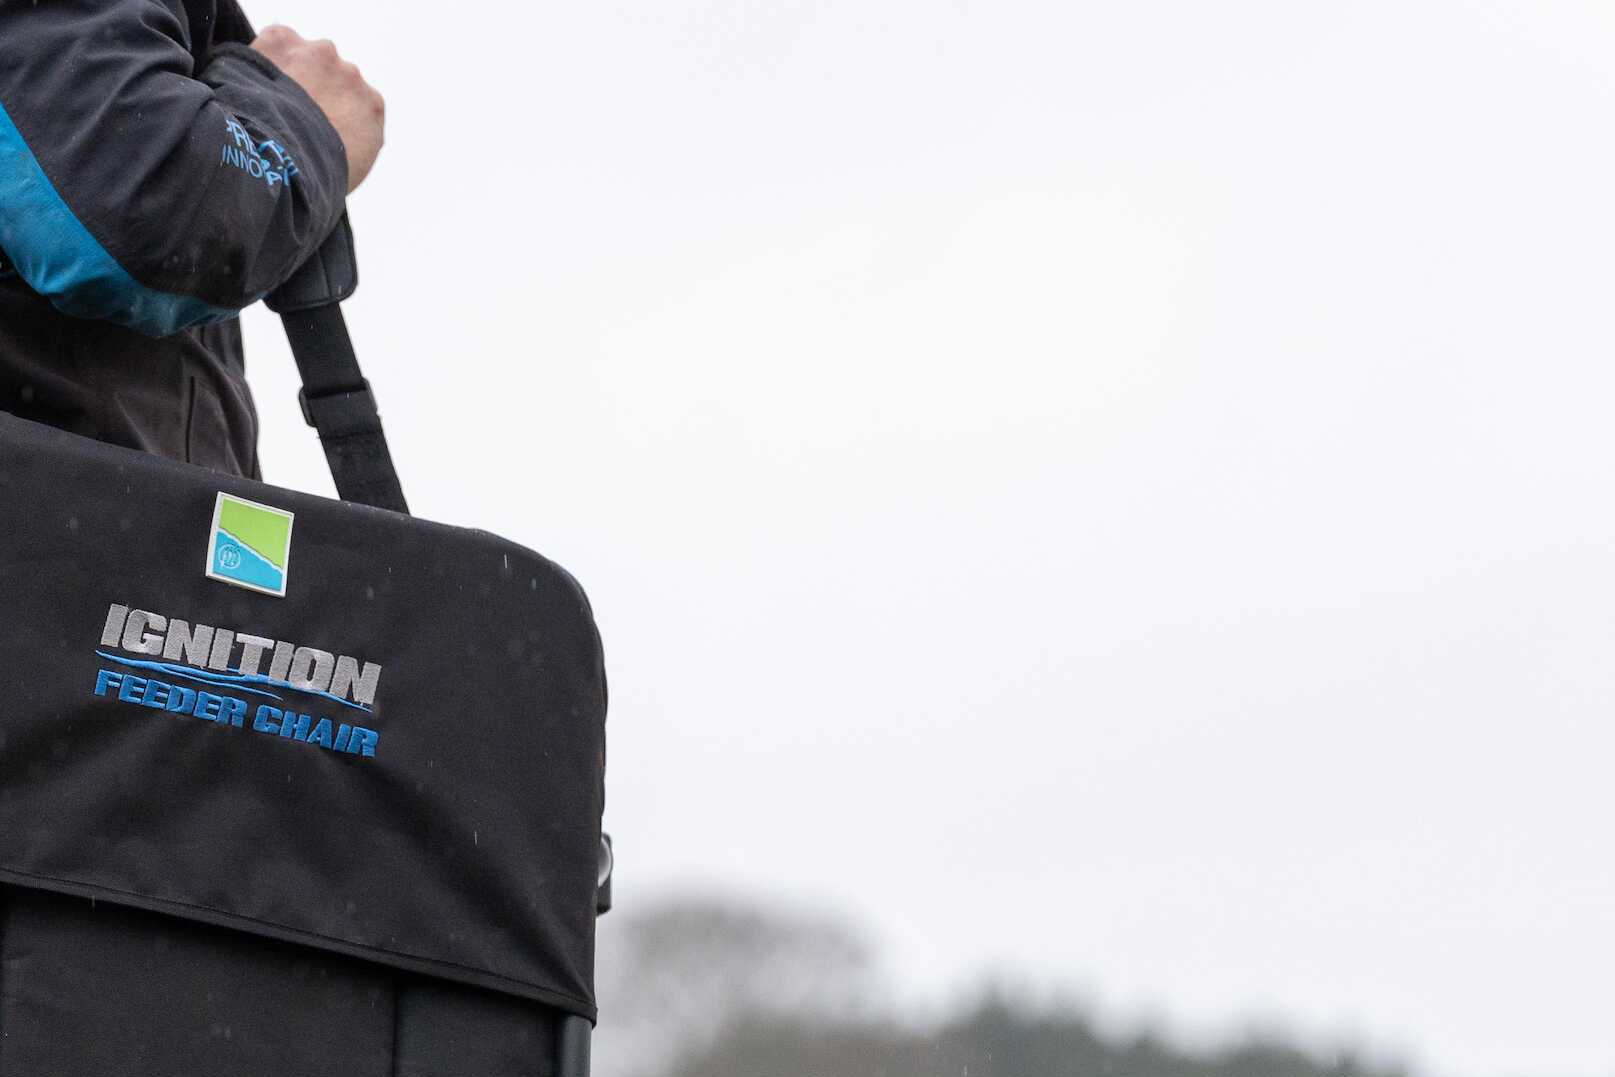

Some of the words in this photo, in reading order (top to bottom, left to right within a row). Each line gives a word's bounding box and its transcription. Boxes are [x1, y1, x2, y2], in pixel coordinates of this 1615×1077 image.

[100, 603, 382, 704] IGNITION
[94, 669, 247, 728] FEEDER
[252, 704, 379, 757] CHAIR
